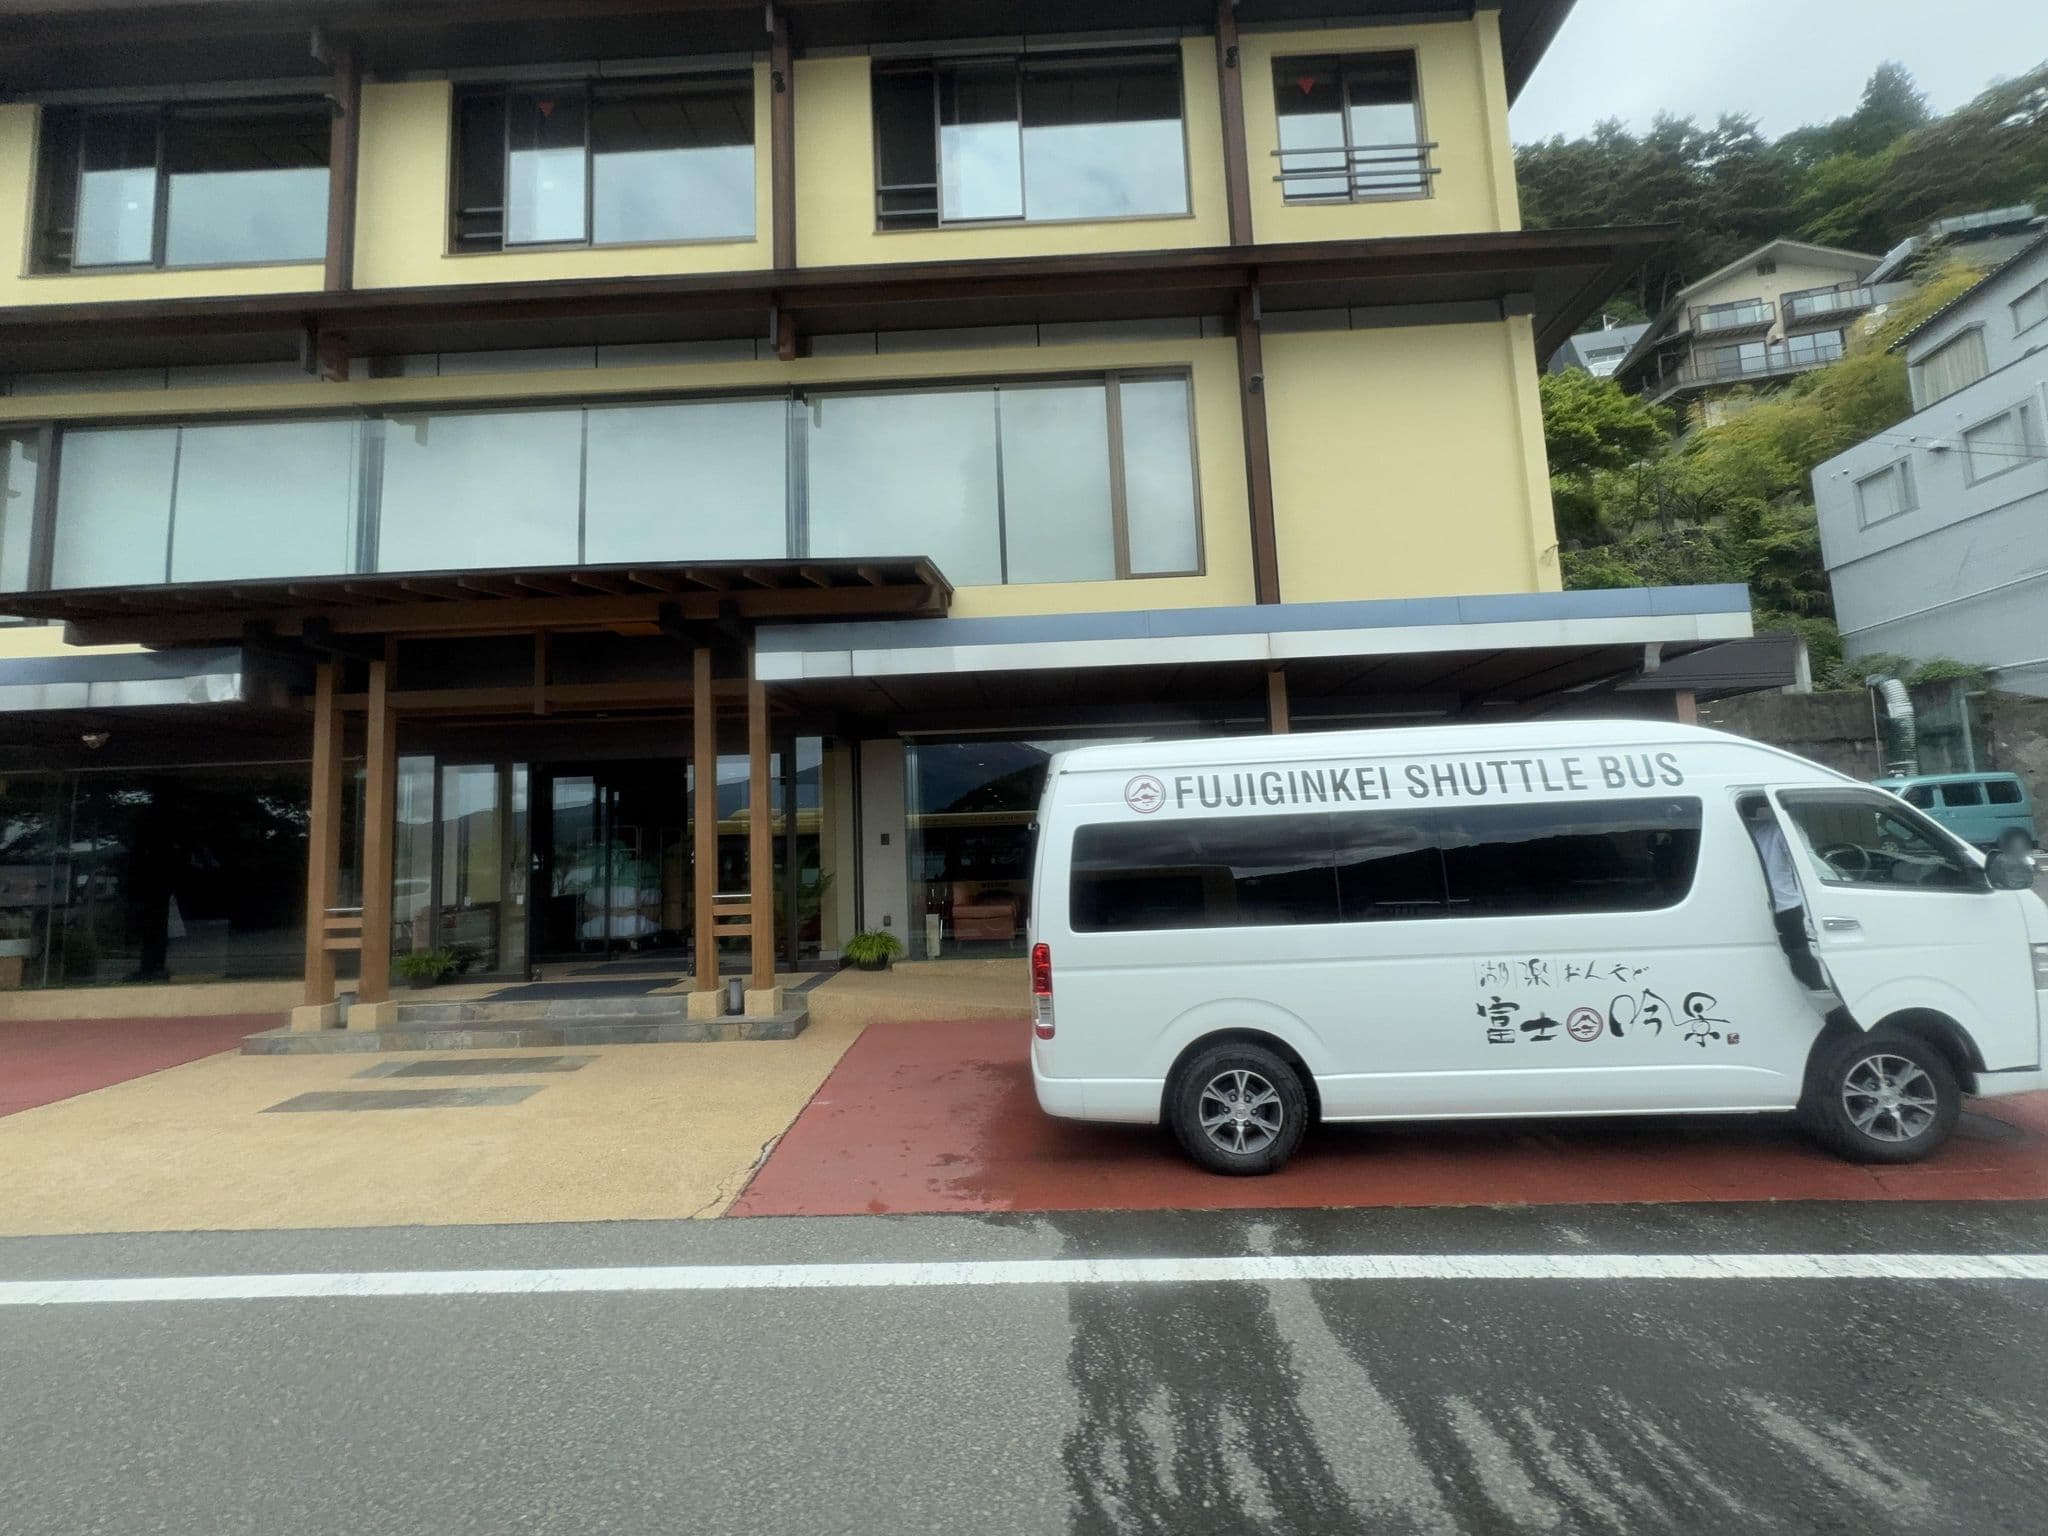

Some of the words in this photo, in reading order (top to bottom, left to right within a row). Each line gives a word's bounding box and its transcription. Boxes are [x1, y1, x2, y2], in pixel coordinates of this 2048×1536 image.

[1175, 767, 1391, 809] FUJIGINKEI
[1407, 756, 1587, 798] SHUTTLE
[1597, 752, 1685, 789] BUS
